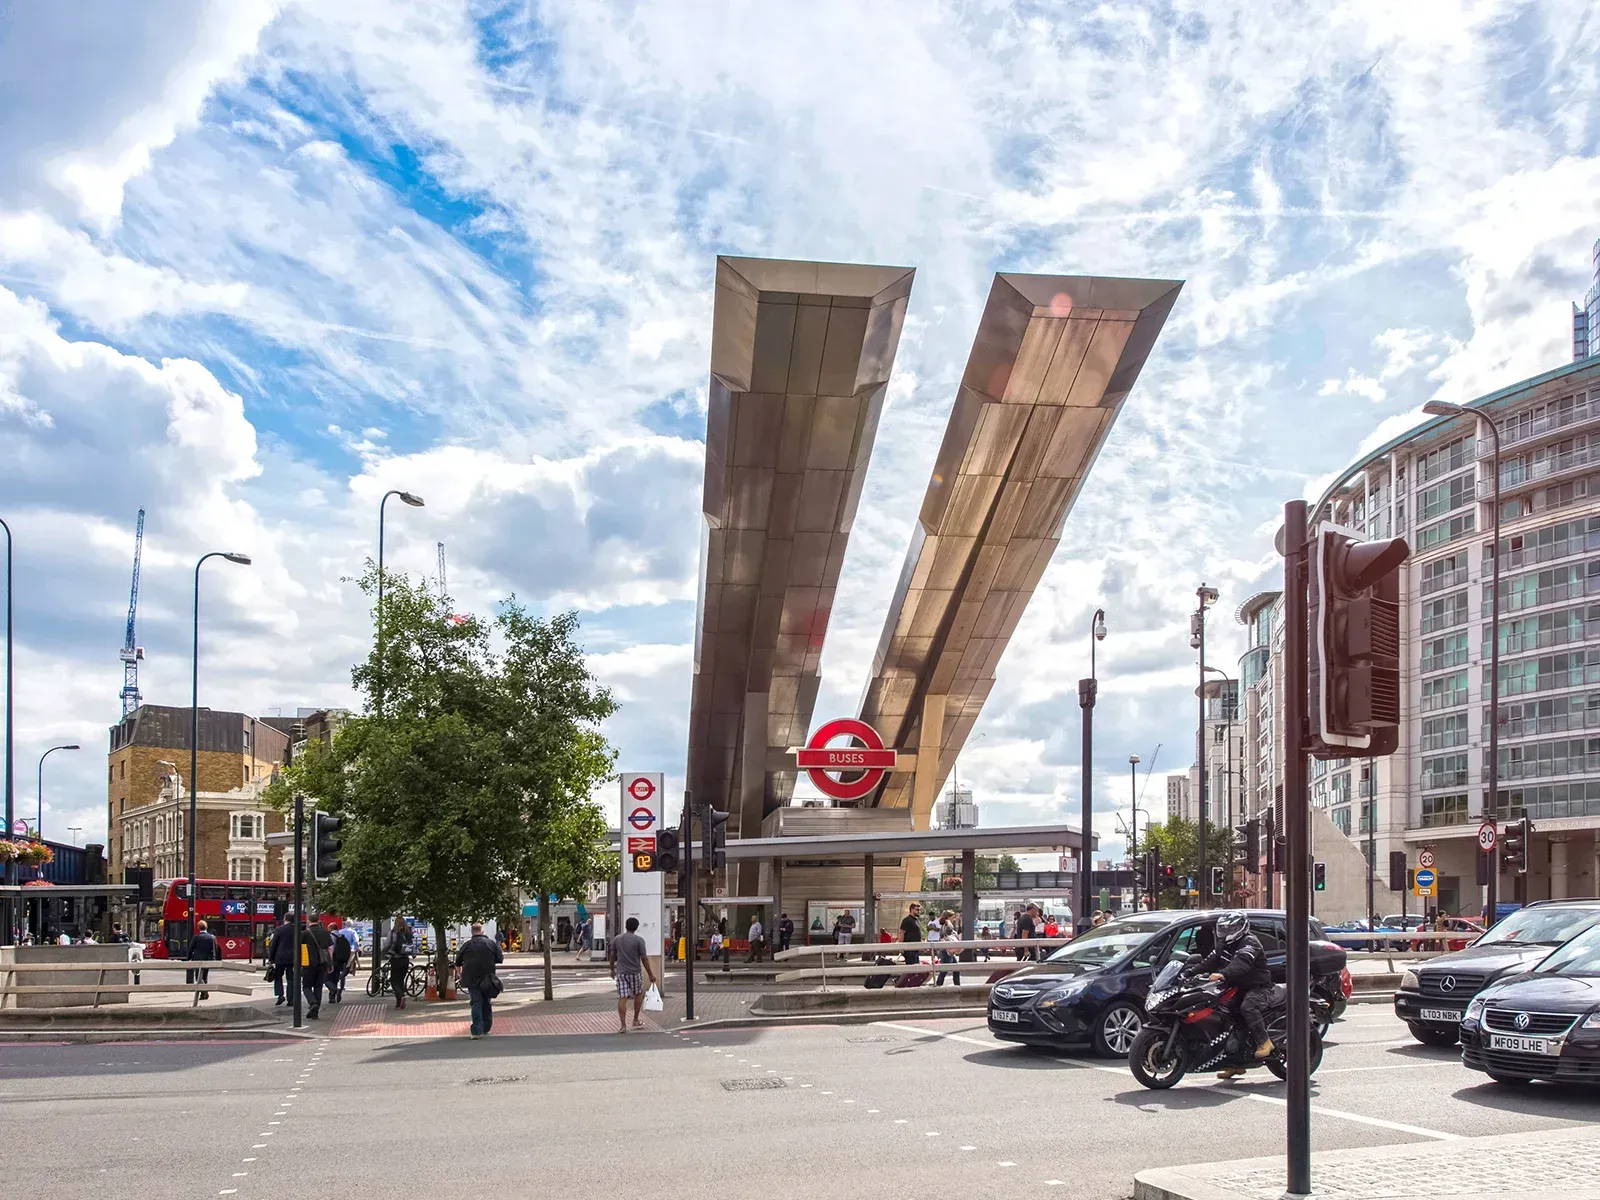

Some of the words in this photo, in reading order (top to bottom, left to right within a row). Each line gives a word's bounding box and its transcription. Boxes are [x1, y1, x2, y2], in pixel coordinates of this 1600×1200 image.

[829, 753, 865, 763] BUSES
[1560, 820, 1587, 828] WHARF
[1480, 831, 1494, 844] 30
[637, 856, 651, 868] 02
[1422, 855, 1433, 863] 20
[1422, 1010, 1441, 1019] LT03
[1442, 1011, 1458, 1020] NBK
[1494, 1037, 1519, 1049] MF09
[1521, 1040, 1543, 1052] LHE
